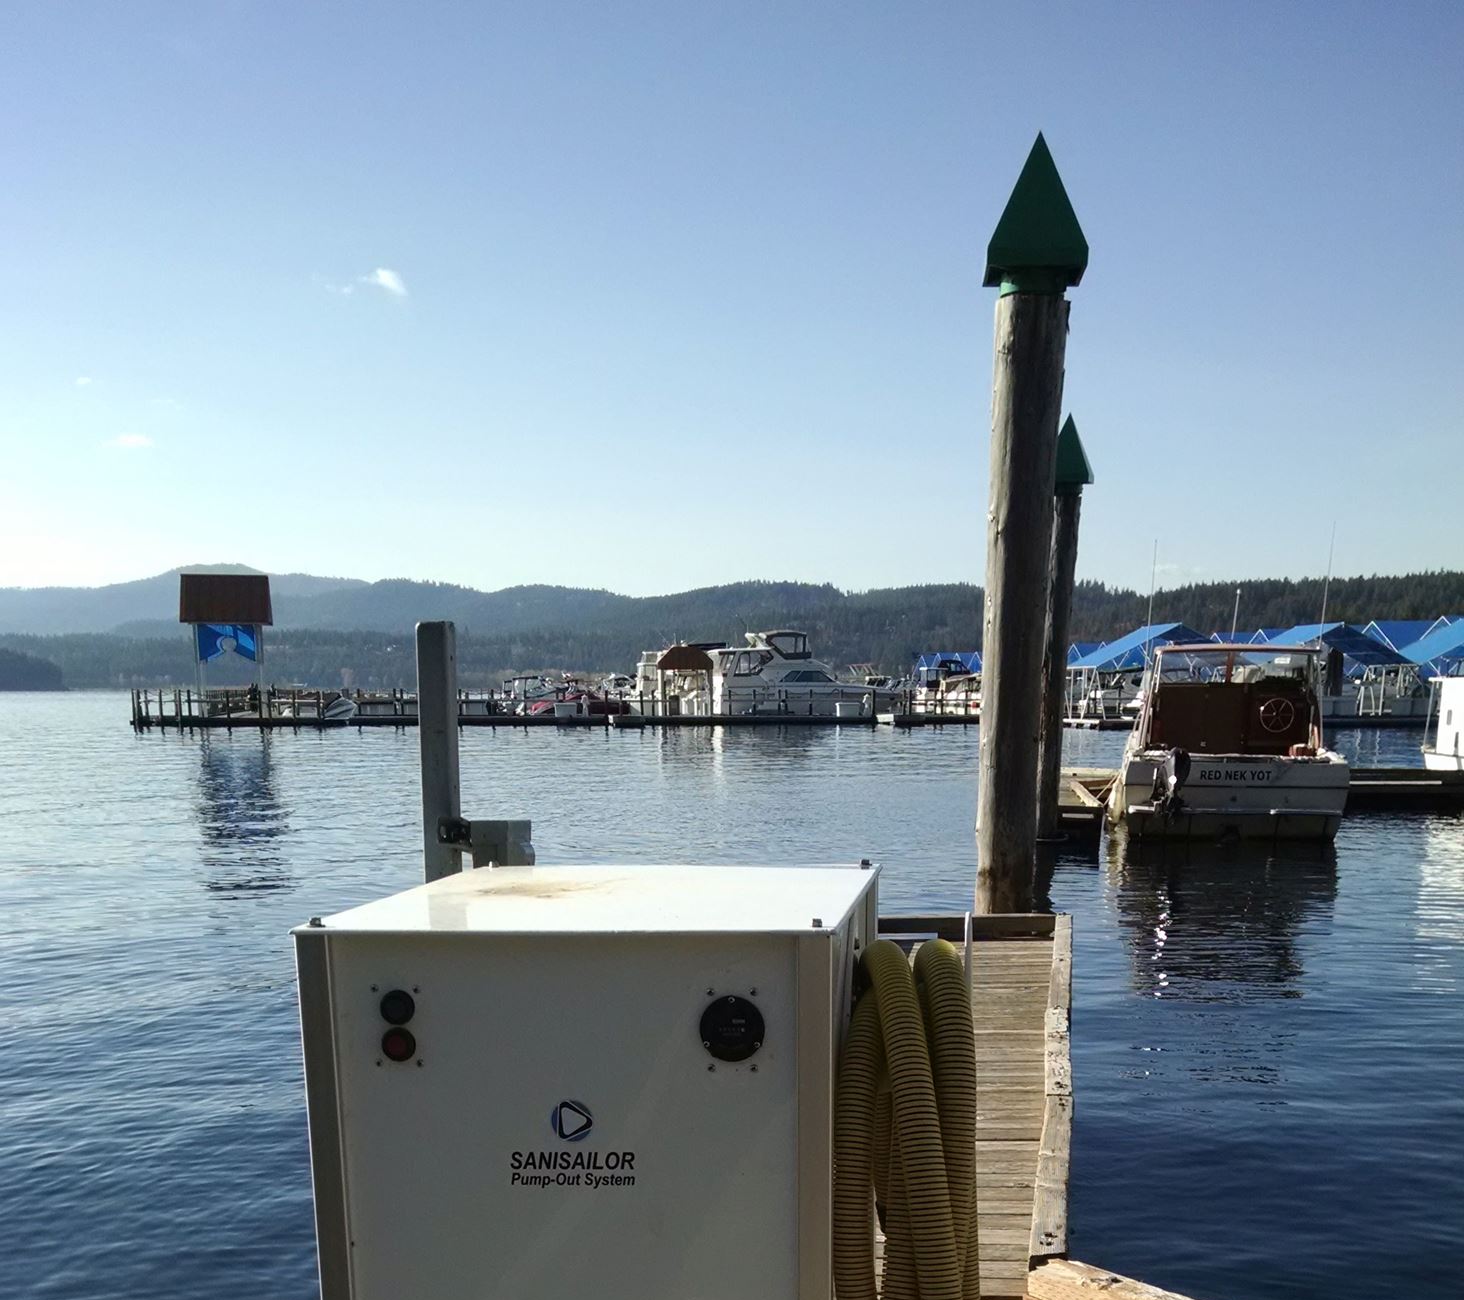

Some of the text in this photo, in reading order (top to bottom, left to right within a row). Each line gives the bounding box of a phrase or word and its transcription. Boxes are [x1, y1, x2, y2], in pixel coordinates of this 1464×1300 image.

[1200, 769, 1272, 781] RED NEK YOT
[510, 1151, 635, 1170] SANISAILOR
[511, 1172, 635, 1189] Pump-Out System
